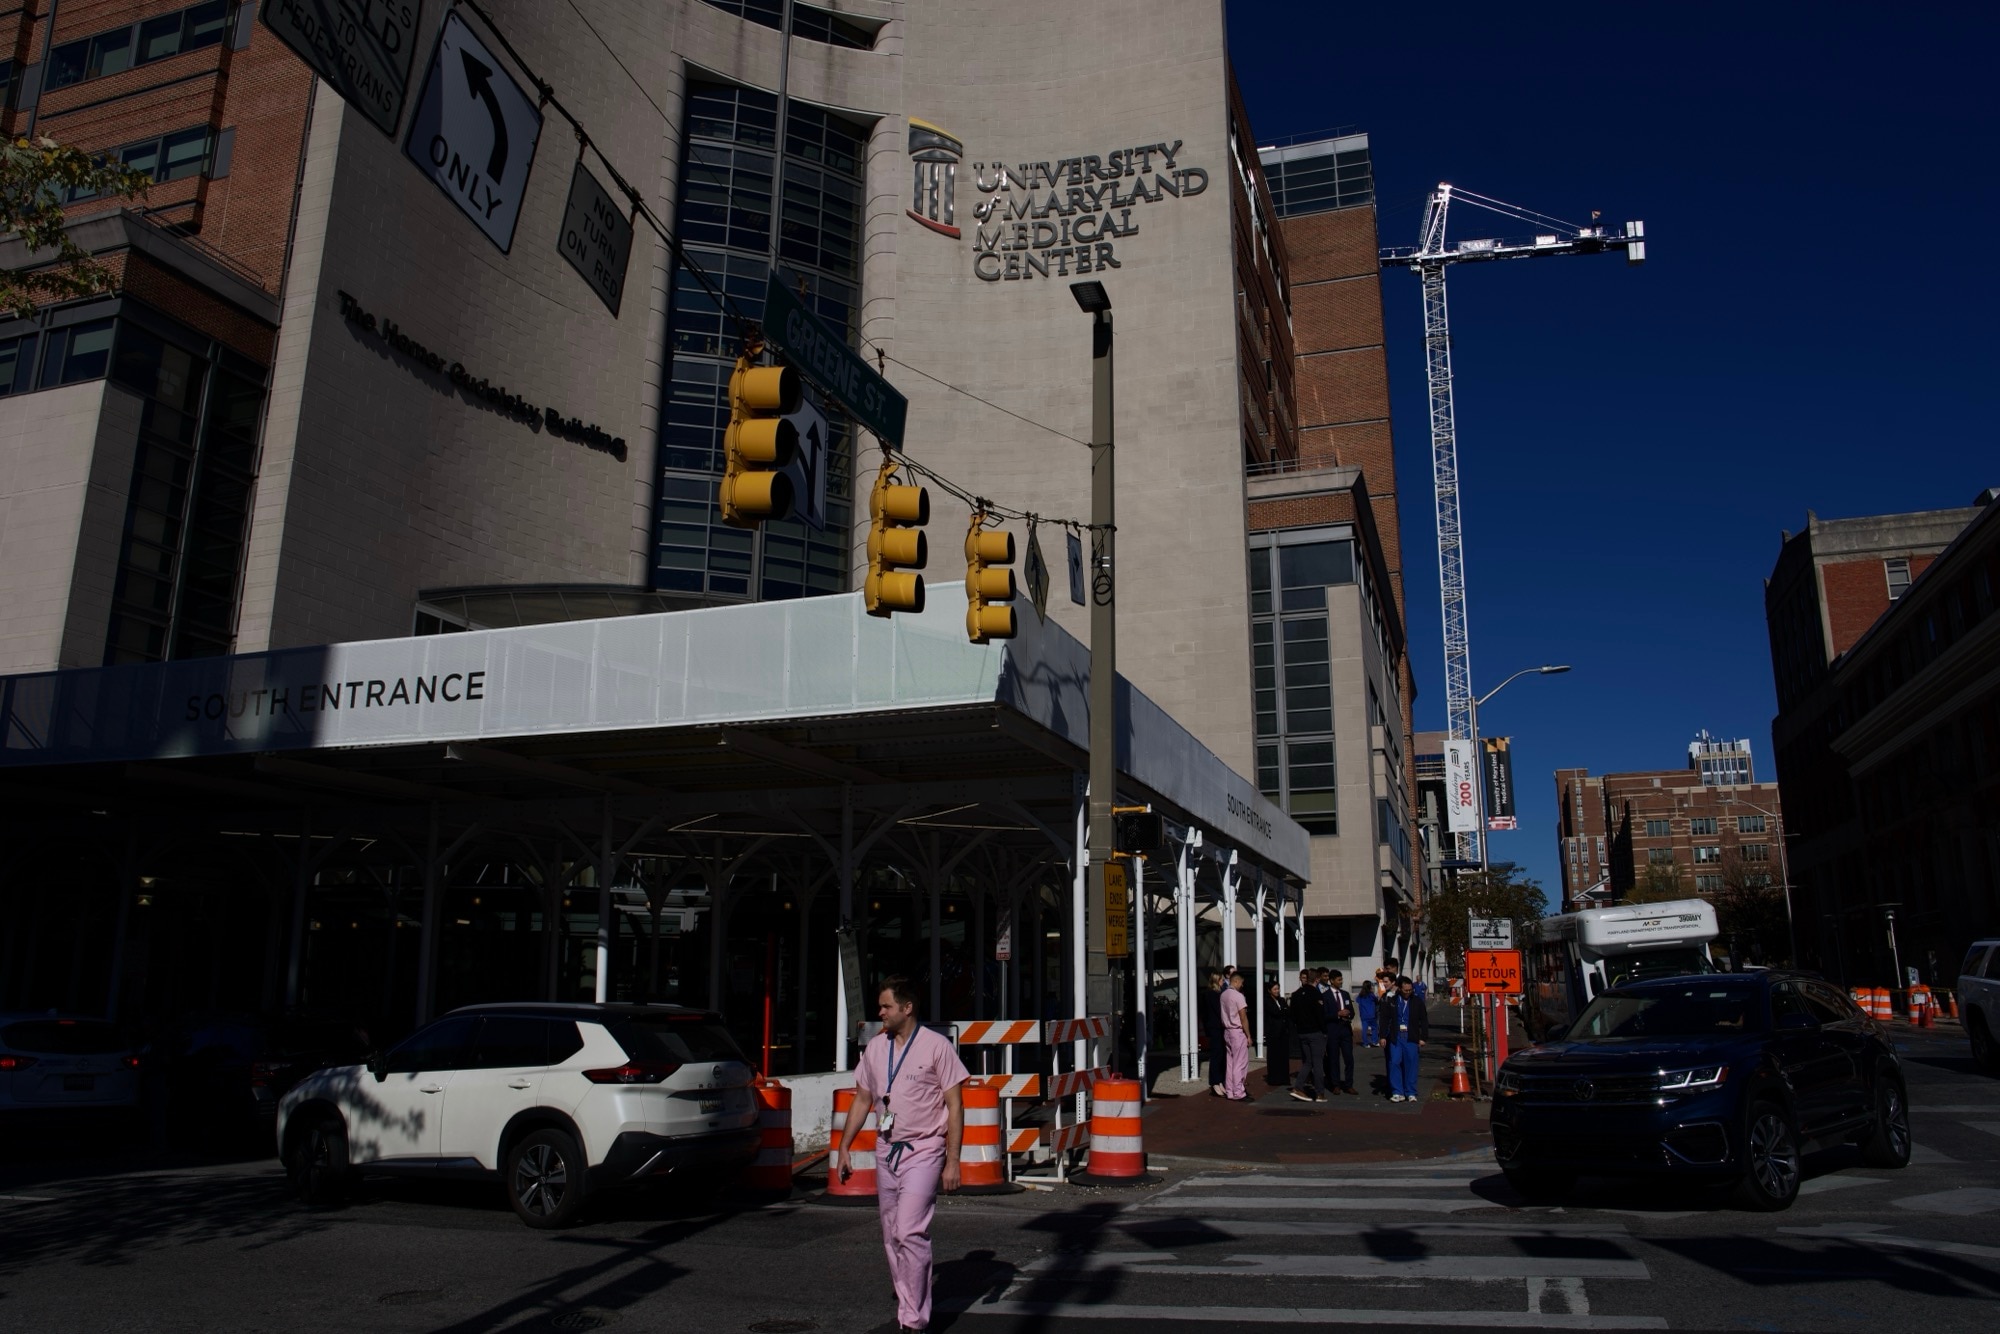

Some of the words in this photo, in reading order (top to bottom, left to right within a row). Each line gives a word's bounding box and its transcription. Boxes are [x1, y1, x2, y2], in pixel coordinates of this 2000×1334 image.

[338, 13, 356, 46] TO
[280, 0, 393, 112] PEDESTRIANS
[429, 134, 502, 220] ONLY
[973, 139, 1183, 193] UNIVERSITY
[593, 196, 615, 231] NO
[973, 194, 1001, 223] of
[1003, 167, 1209, 220] MARYLAND
[583, 212, 616, 266] TURN
[973, 209, 1139, 251] MEDICAL
[567, 230, 587, 262] ON
[593, 261, 618, 298] RED
[973, 242, 1121, 281] CENTER
[338, 289, 376, 331] The
[382, 318, 447, 374] Homer
[449, 361, 540, 424] Gudelsky
[545, 406, 626, 459] Building
[786, 307, 862, 400] GREENE
[863, 381, 888, 425] ST.
[185, 686, 290, 722] SOUTH
[299, 671, 486, 713] ENTRANCE
[1227, 793, 1247, 822] SOUTH
[1246, 805, 1272, 840] ENTRANCE
[1460, 782, 1472, 807] 200
[1108, 873, 1123, 887] LANE
[1109, 891, 1123, 905] ENDS
[1108, 914, 1125, 928] MERGE
[1111, 933, 1123, 946] LEFT
[1472, 968, 1517, 979] DETOUR
